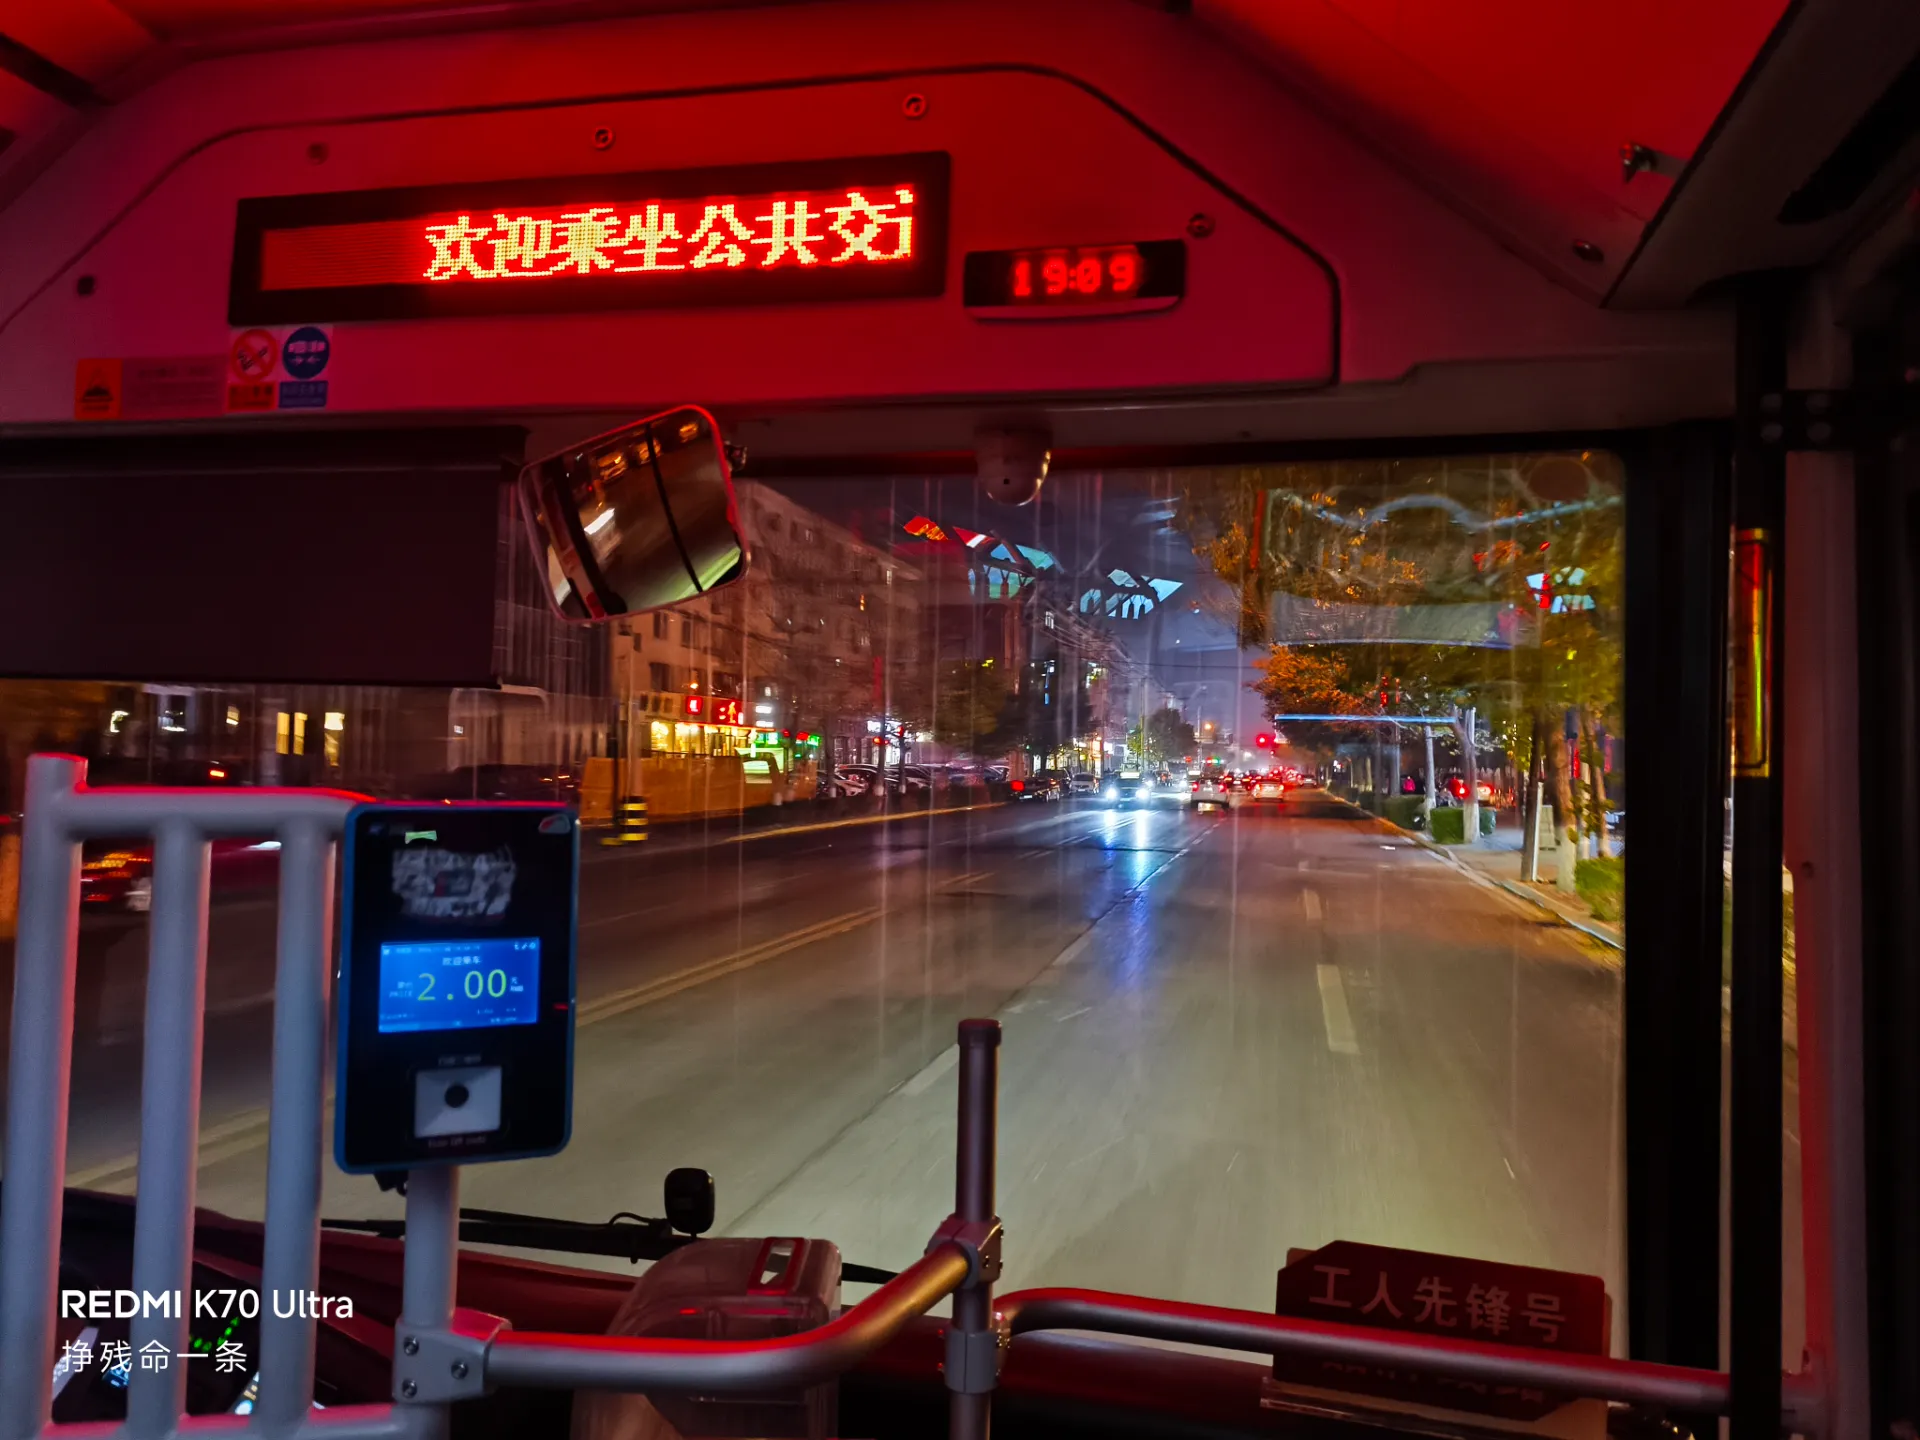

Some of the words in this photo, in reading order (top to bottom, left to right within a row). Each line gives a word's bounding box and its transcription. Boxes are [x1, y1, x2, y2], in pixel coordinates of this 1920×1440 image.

[423, 189, 914, 281] 欢迎乘坐公共交
[1013, 253, 1136, 297] 19:09
[417, 968, 507, 1001] 2.00
[1308, 1264, 1567, 1343] 工人先锋号
